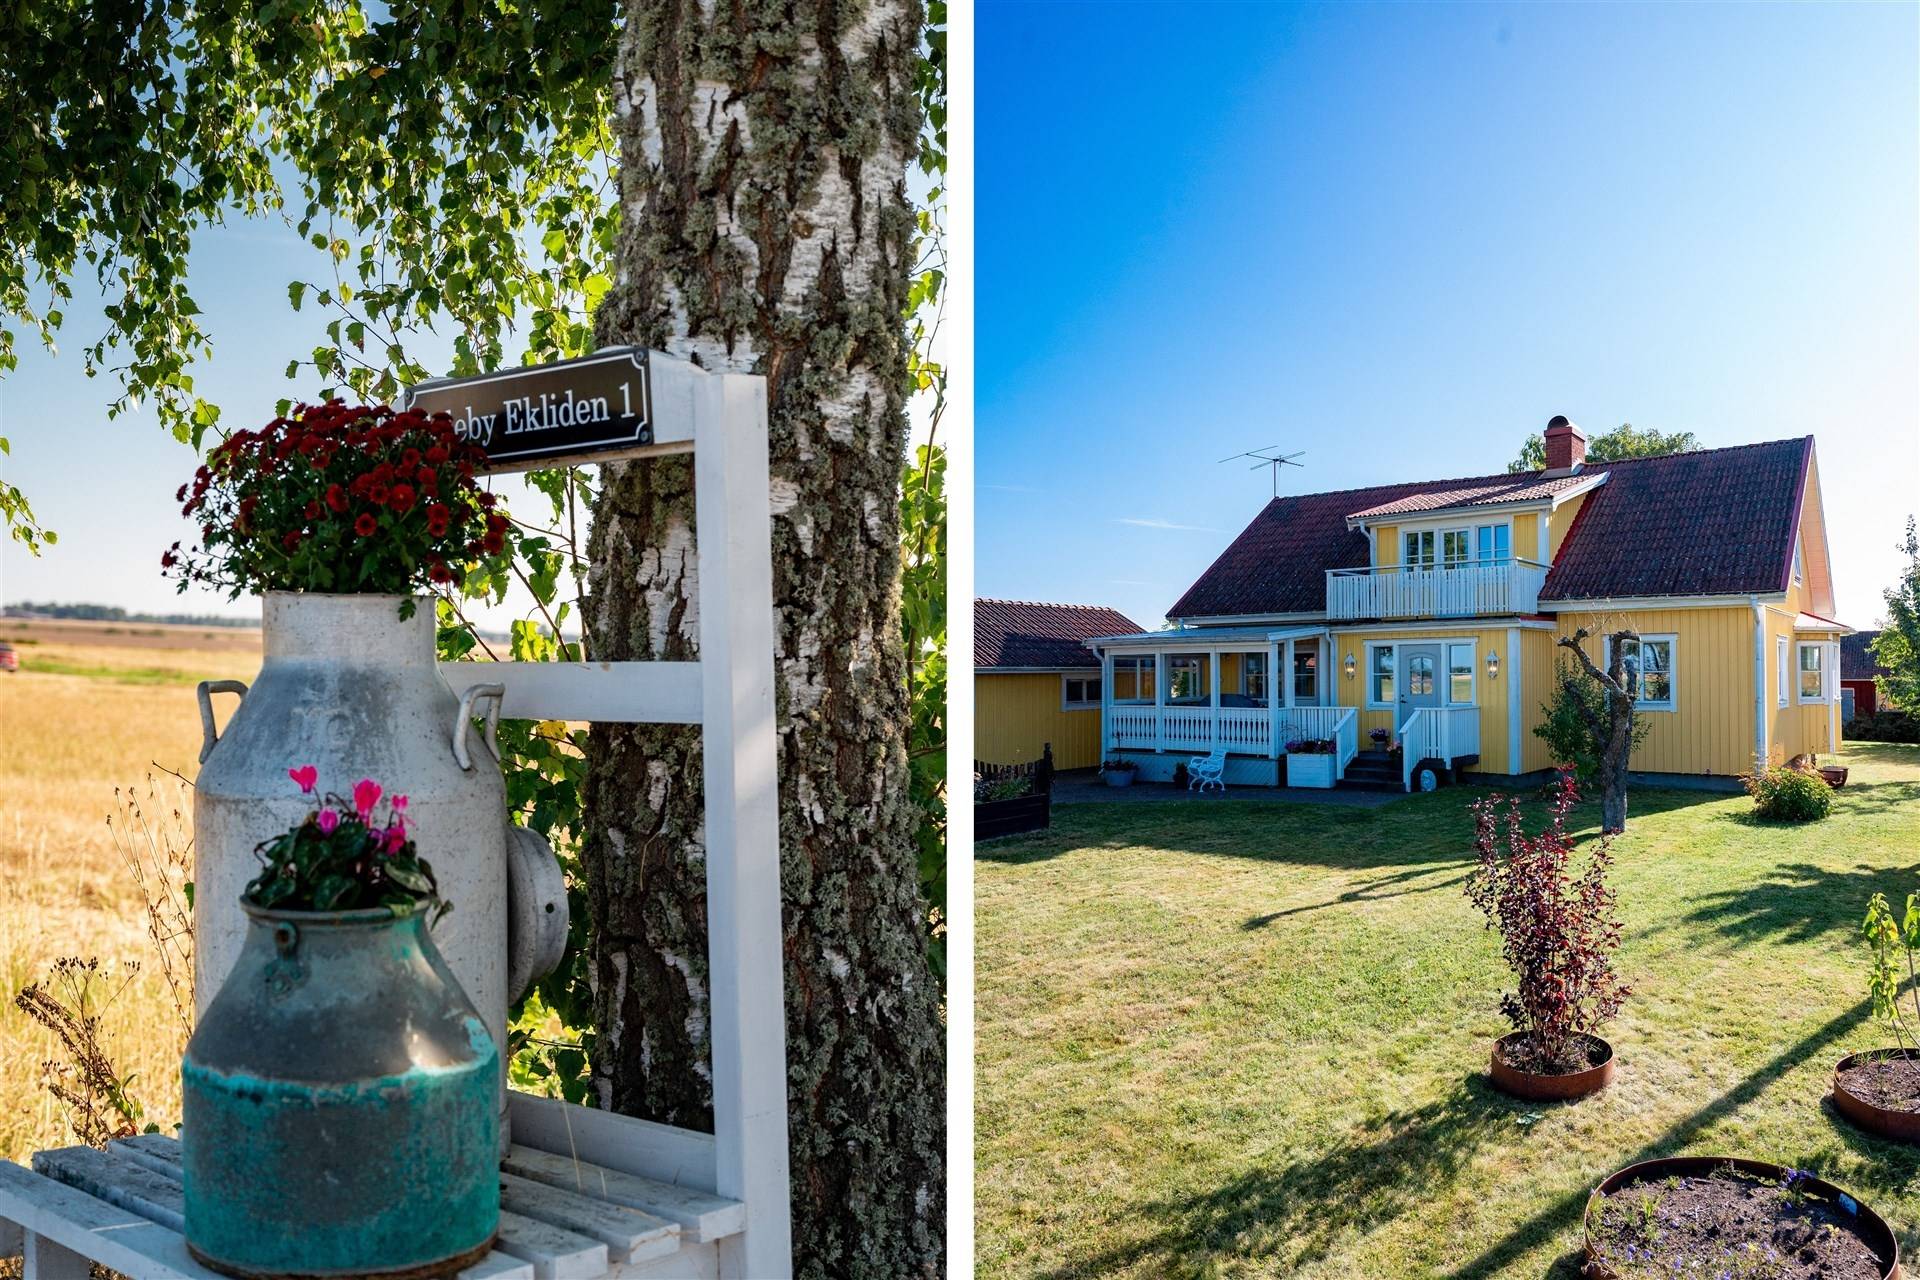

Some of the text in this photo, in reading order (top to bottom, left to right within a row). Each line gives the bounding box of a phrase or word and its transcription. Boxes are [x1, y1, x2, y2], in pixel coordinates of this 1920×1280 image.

[445, 381, 635, 446] eby Ekliden 1
